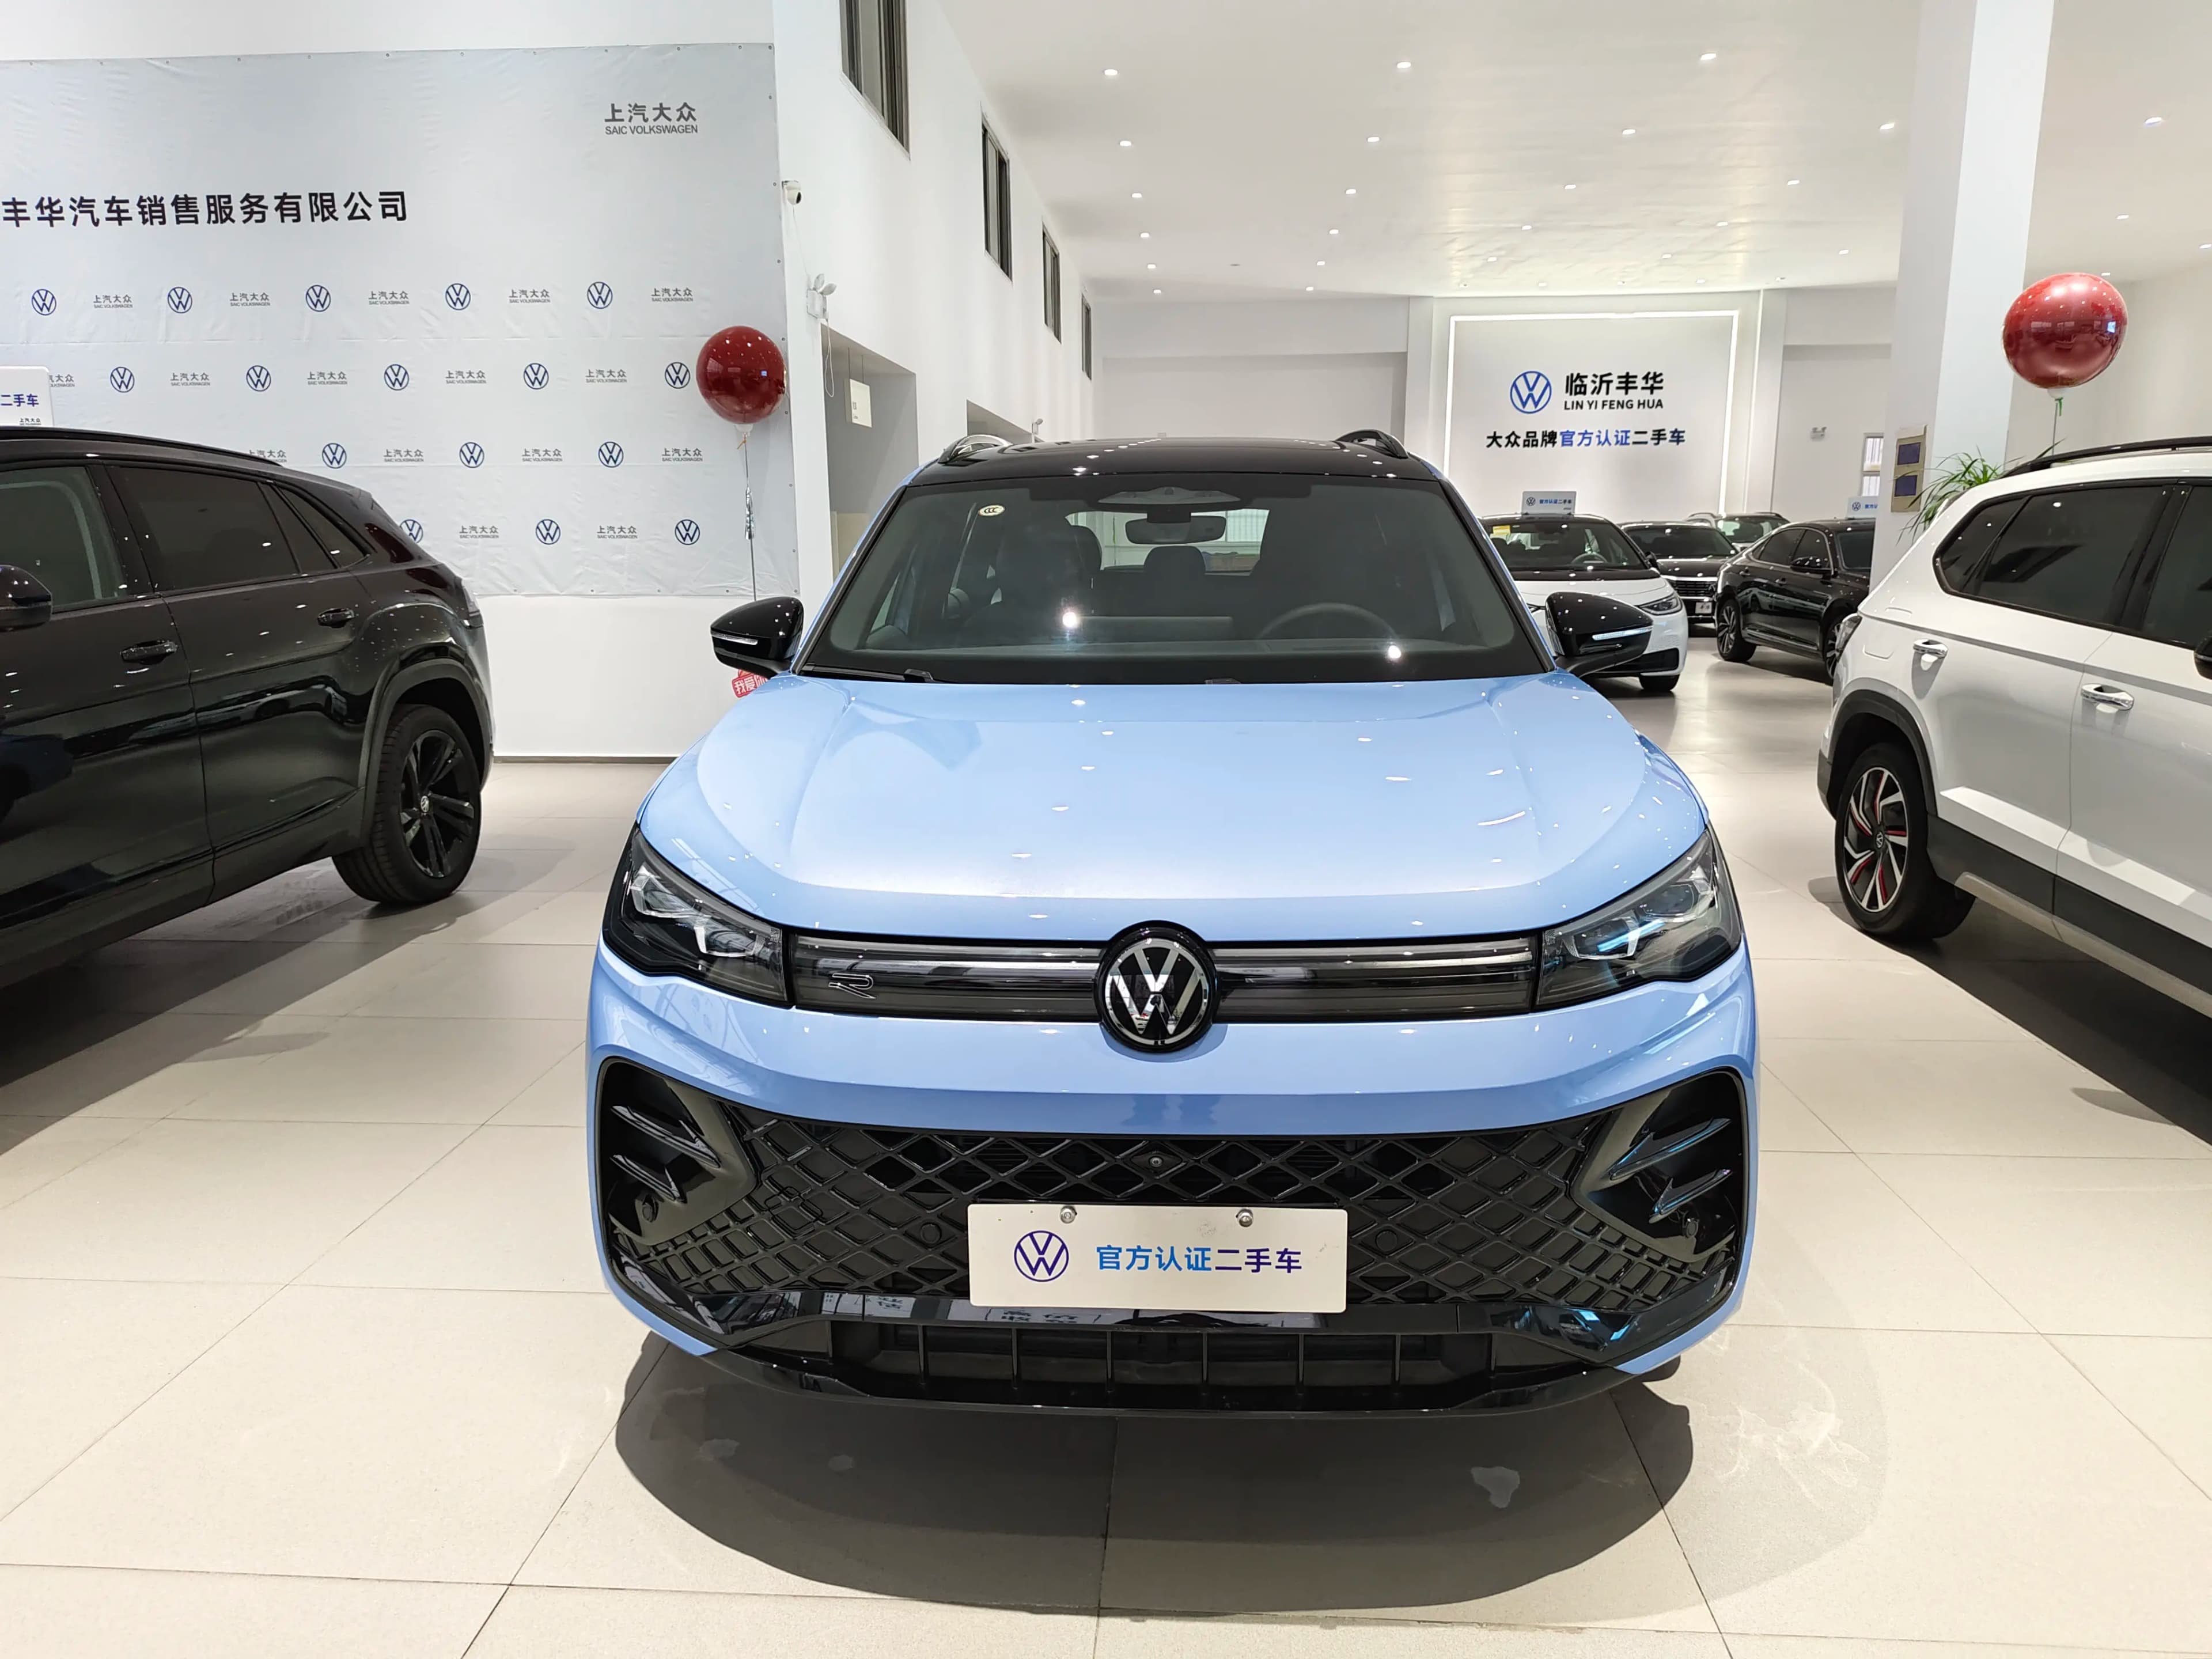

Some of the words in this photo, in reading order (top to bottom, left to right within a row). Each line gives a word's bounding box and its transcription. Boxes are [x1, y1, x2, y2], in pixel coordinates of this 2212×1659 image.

[604, 102, 696, 123] 上汽大众
[605, 126, 627, 135] SAIC
[629, 124, 698, 134] VOLKSWAGEN
[2, 191, 407, 228] 丰华汽车销售服务有限公司
[369, 291, 408, 300] 上汽大众
[509, 289, 550, 298] 上汽大众
[651, 287, 692, 297] 上汽大众
[93, 294, 132, 304] 上汽大众
[230, 293, 270, 301] 上汽大众
[49, 374, 74, 382] 大众
[171, 372, 210, 381] 上汽大众
[307, 372, 347, 380] 上汽大众
[445, 370, 486, 379] 上汽大众
[585, 369, 626, 378] 上汽大众
[1565, 372, 1664, 396] 临沂丰华
[1, 393, 39, 407] 二手车
[1564, 400, 1584, 410] LIN
[1587, 400, 1597, 410] YI
[1601, 400, 1633, 410] FENG
[1638, 399, 1664, 409] HUA
[1486, 428, 1685, 448] 大众品牌官方认证二手车
[384, 449, 423, 457] 上汽大众
[522, 448, 562, 457] 上汽大众
[662, 448, 702, 457] 上汽大众
[459, 525, 498, 533] 上汽大众
[597, 525, 637, 534] 上汽大众
[1096, 1244, 1302, 1274] 官方认证二手车
